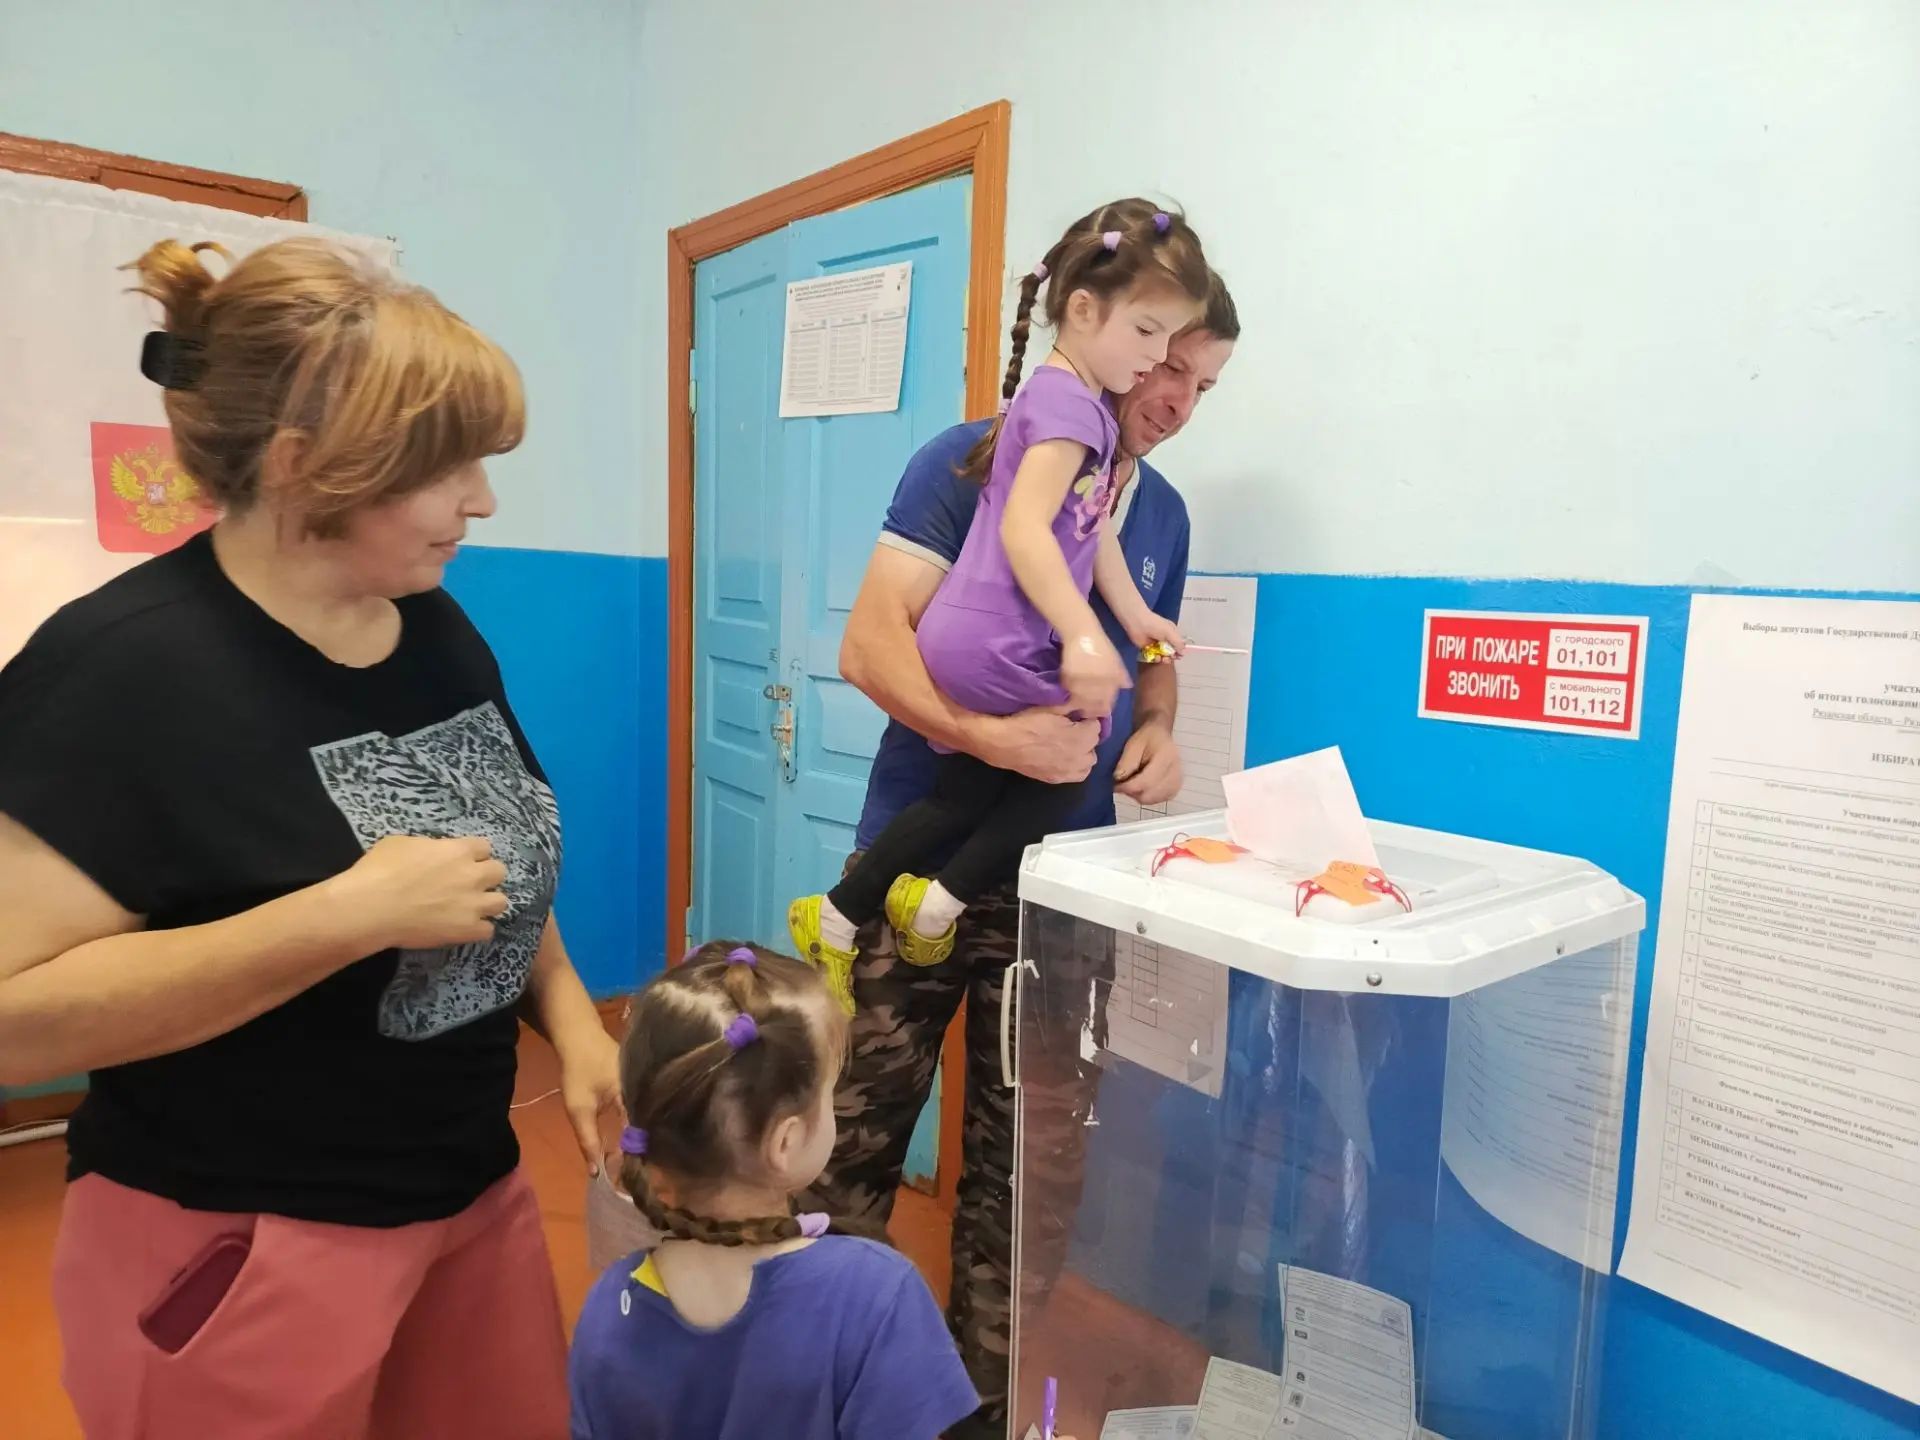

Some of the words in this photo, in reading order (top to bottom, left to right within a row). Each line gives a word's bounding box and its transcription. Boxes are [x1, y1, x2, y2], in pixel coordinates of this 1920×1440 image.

[1743, 622, 1778, 634] Выборы
[1827, 627, 1908, 640] Государственной
[1435, 635, 1466, 660] ПРИ
[1472, 637, 1541, 666] ПОЖАРЕ
[1565, 636, 1624, 647] ГОРОДСКОГО
[1557, 648, 1617, 668] 01,101
[1447, 670, 1520, 700] ЗВОНИТЬ
[1559, 683, 1621, 696] МОБИЛЬНОГО
[1549, 695, 1620, 716] 101,112
[1804, 689, 1816, 699] об
[1818, 692, 1853, 702] итогах
[1856, 695, 1920, 709] голосовани
